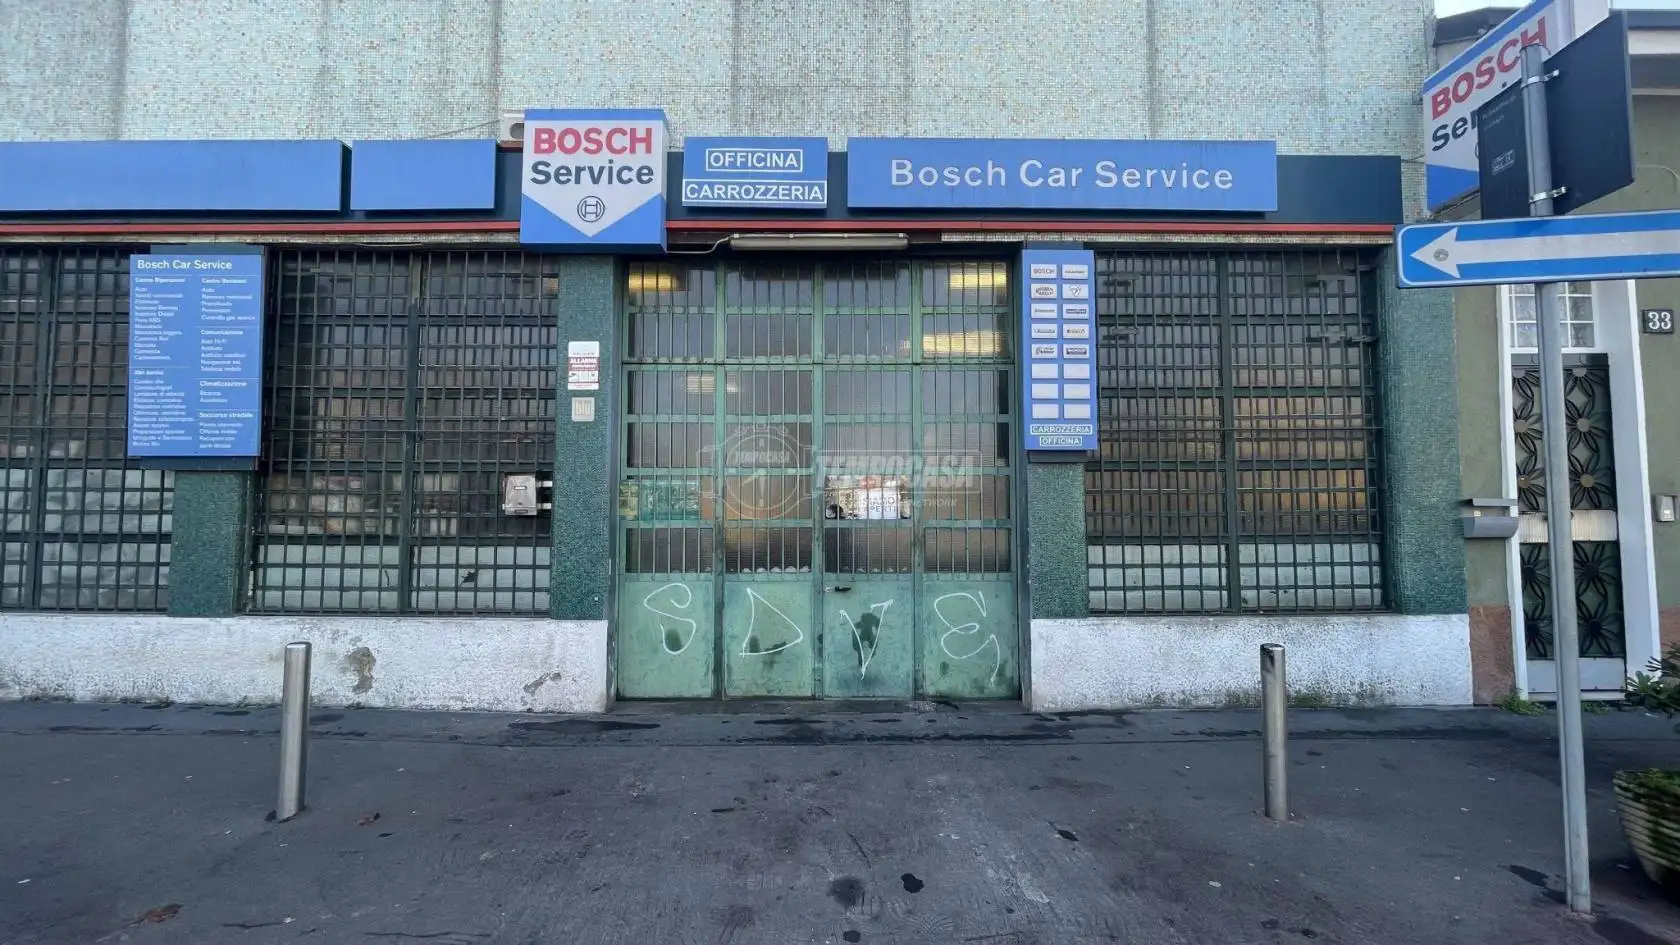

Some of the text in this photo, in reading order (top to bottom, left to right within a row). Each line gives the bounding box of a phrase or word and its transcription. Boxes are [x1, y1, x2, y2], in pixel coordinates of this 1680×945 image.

[1431, 16, 1547, 121] BOSCH
[533, 127, 652, 155] BOSCH
[1431, 110, 1479, 152] Ser
[709, 151, 799, 168] OFFICINA
[530, 159, 654, 185] Service
[891, 159, 1233, 190] Bosch Car Service
[686, 183, 823, 200] CARROZZERIA
[137, 259, 233, 270] Bosch Car Service
[1648, 311, 1672, 330] 33
[1032, 425, 1090, 433] CARROZZERIA
